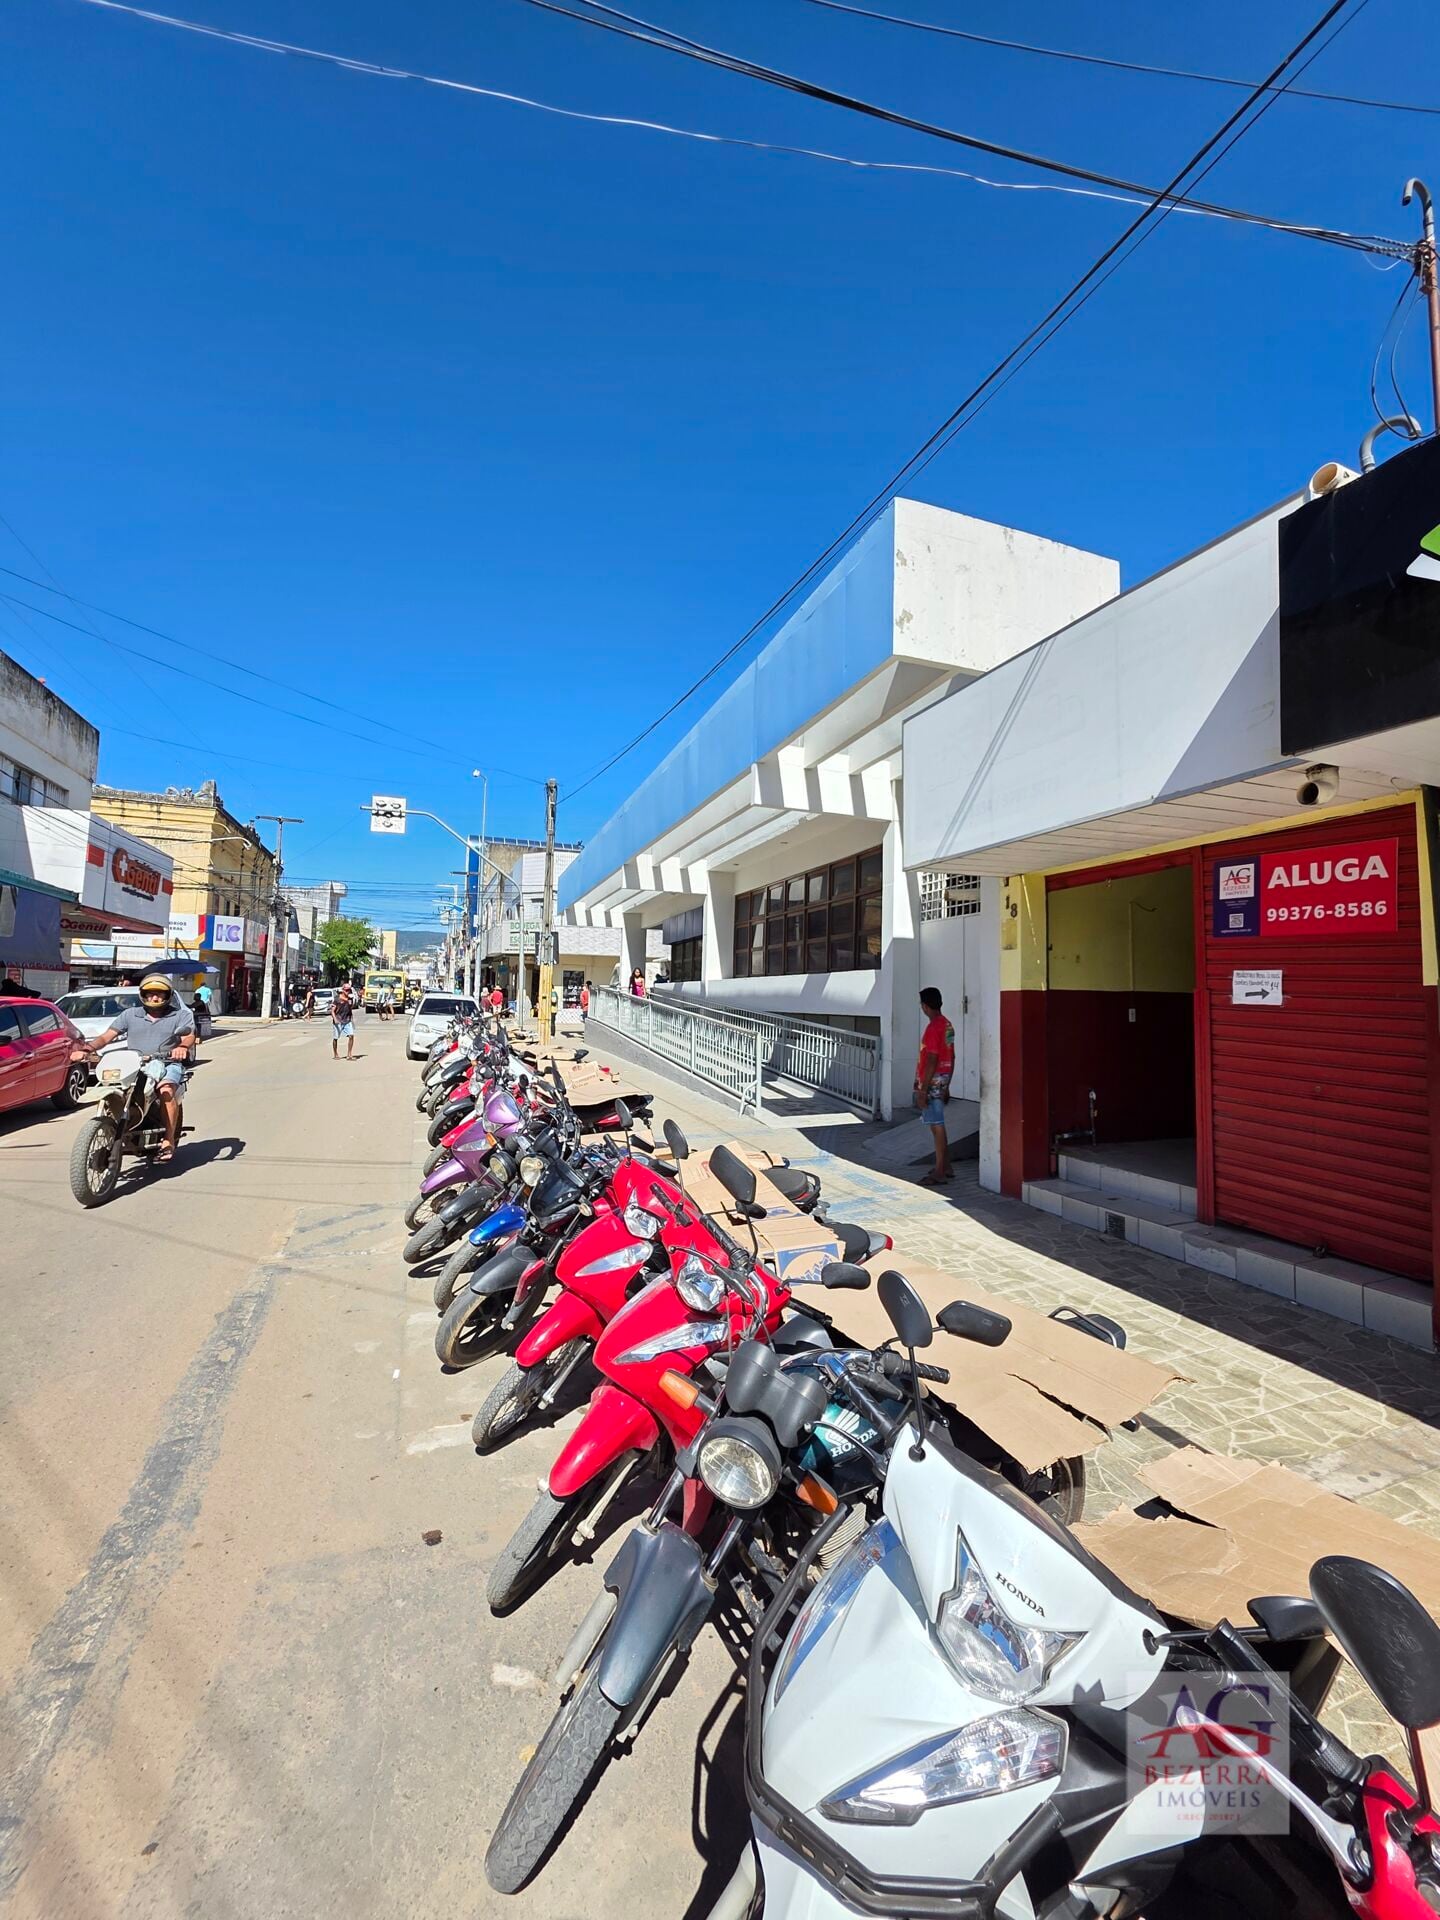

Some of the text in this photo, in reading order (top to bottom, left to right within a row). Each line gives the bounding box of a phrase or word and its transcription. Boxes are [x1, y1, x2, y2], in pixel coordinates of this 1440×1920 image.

[1223, 867, 1252, 887] AG
[1267, 855, 1389, 889] ALUGA
[1266, 900, 1388, 922] 99376-8586
[68, 920, 108, 932] Gentil
[510, 921, 541, 930] BOEGA
[830, 1428, 878, 1458] HODA
[995, 1572, 1046, 1618] HONDA
